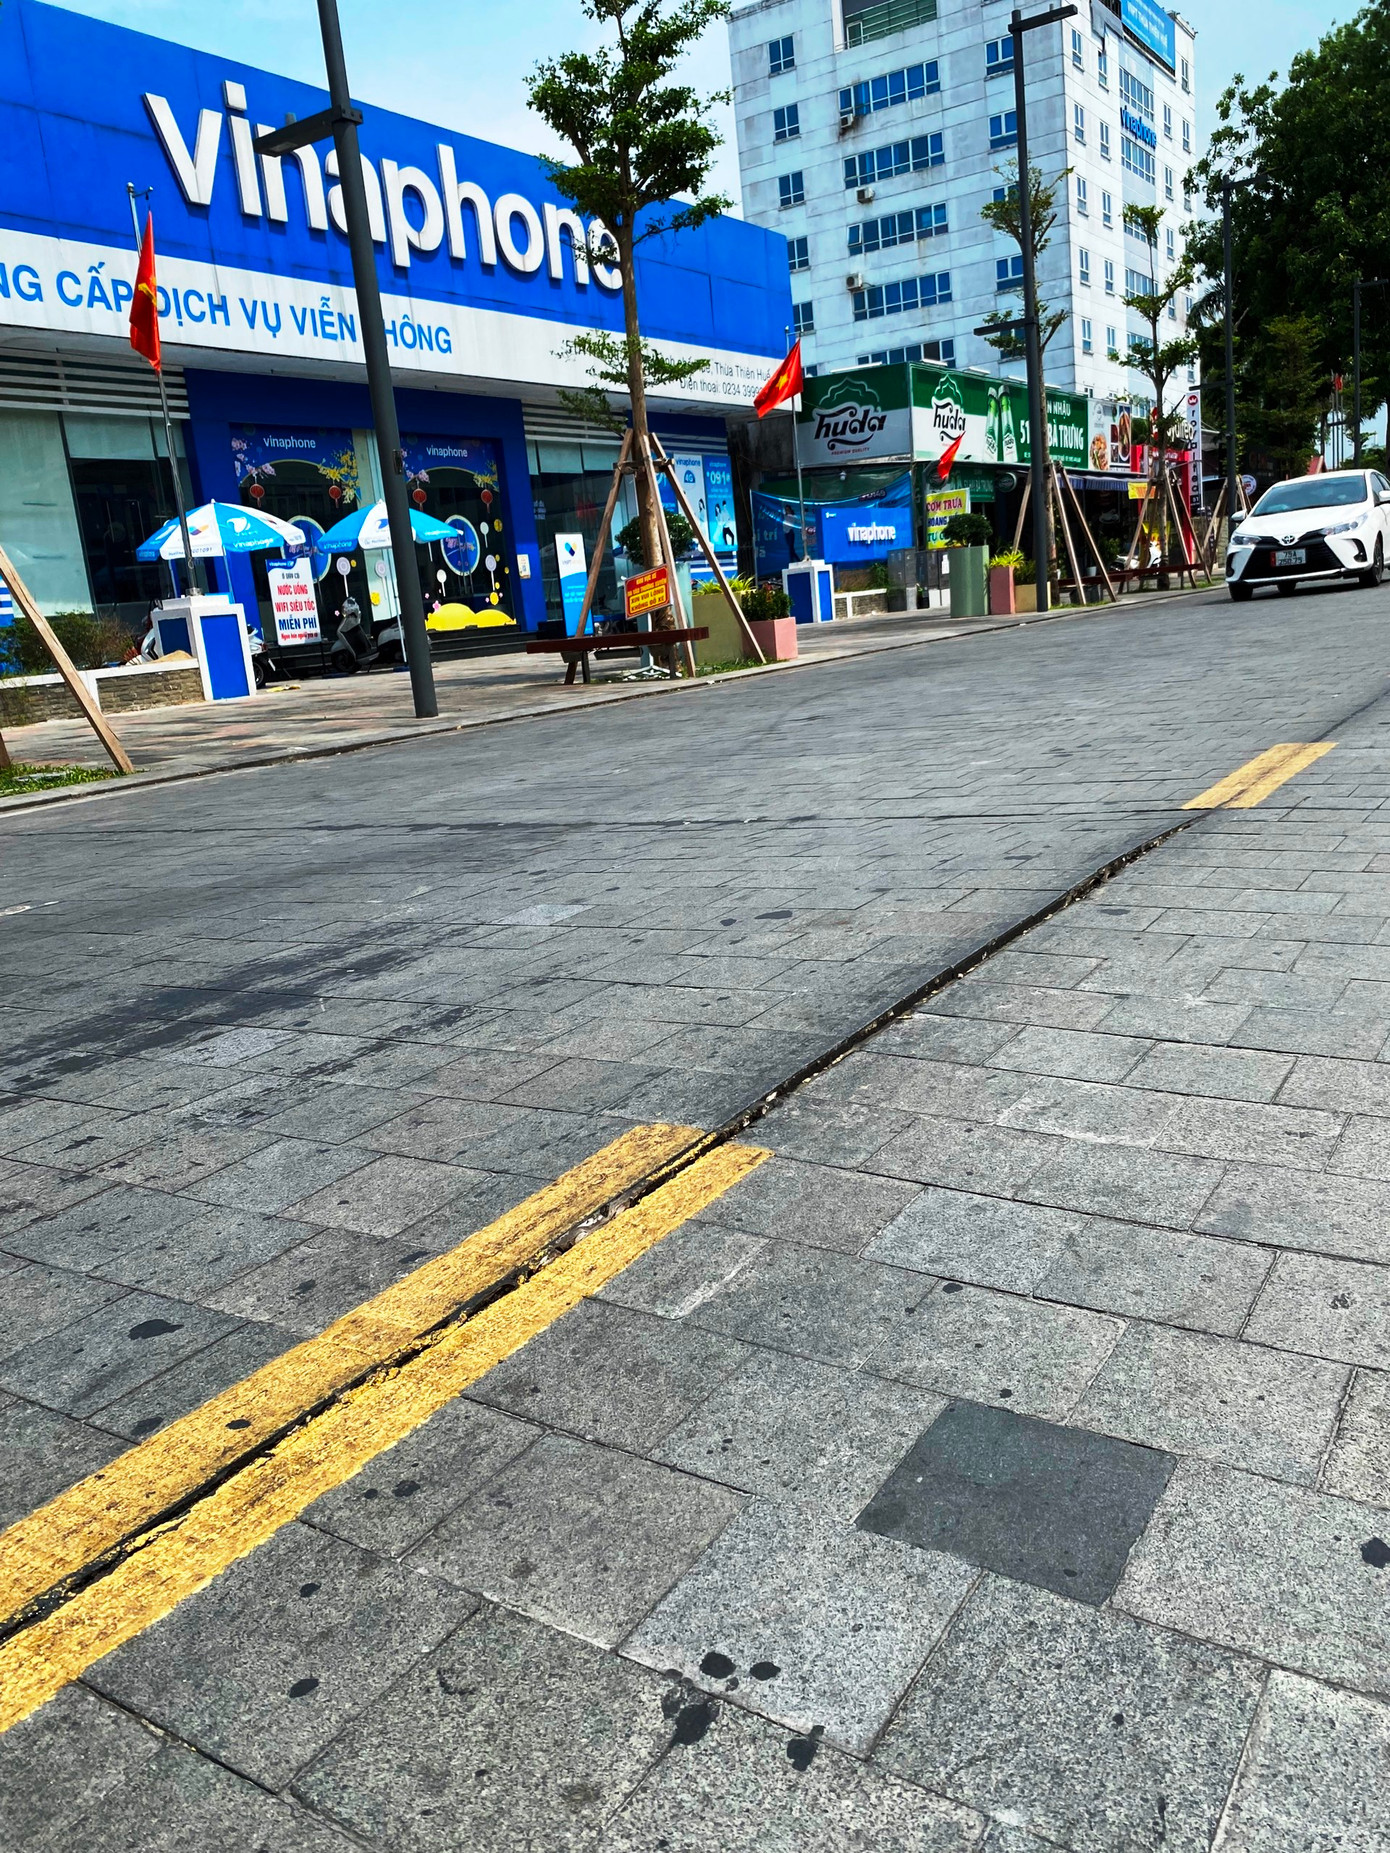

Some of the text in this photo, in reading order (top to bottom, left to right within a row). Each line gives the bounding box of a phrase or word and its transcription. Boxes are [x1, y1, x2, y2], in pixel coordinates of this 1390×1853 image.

[1120, 105, 1156, 149] vinaphone
[145, 80, 624, 290] vinaphone
[56, 261, 134, 312] CẤP
[157, 285, 231, 327] DỊCH
[239, 298, 282, 338] VỤ
[290, 296, 357, 343] VIỄN
[383, 314, 452, 354] HÔNG
[735, 364, 755, 380] Thiên
[757, 367, 771, 382] Huế
[700, 381, 721, 395] thoại:
[722, 382, 741, 396] 0234
[933, 401, 967, 431] huda
[1053, 400, 1071, 420] NHẬU
[814, 405, 887, 440] huda
[263, 435, 316, 450] vinaphone
[426, 445, 468, 459] vinaphone
[676, 457, 702, 467] vinaphone
[685, 473, 694, 482] 4G
[847, 521, 896, 543] vinaphone
[233, 537, 274, 549] vinaphone
[323, 540, 353, 551] vinaphone
[293, 582, 308, 595] UỐNG
[275, 598, 316, 612] WIFI SIÊU TỐC
[279, 614, 317, 631] MIỄN PHÍ
